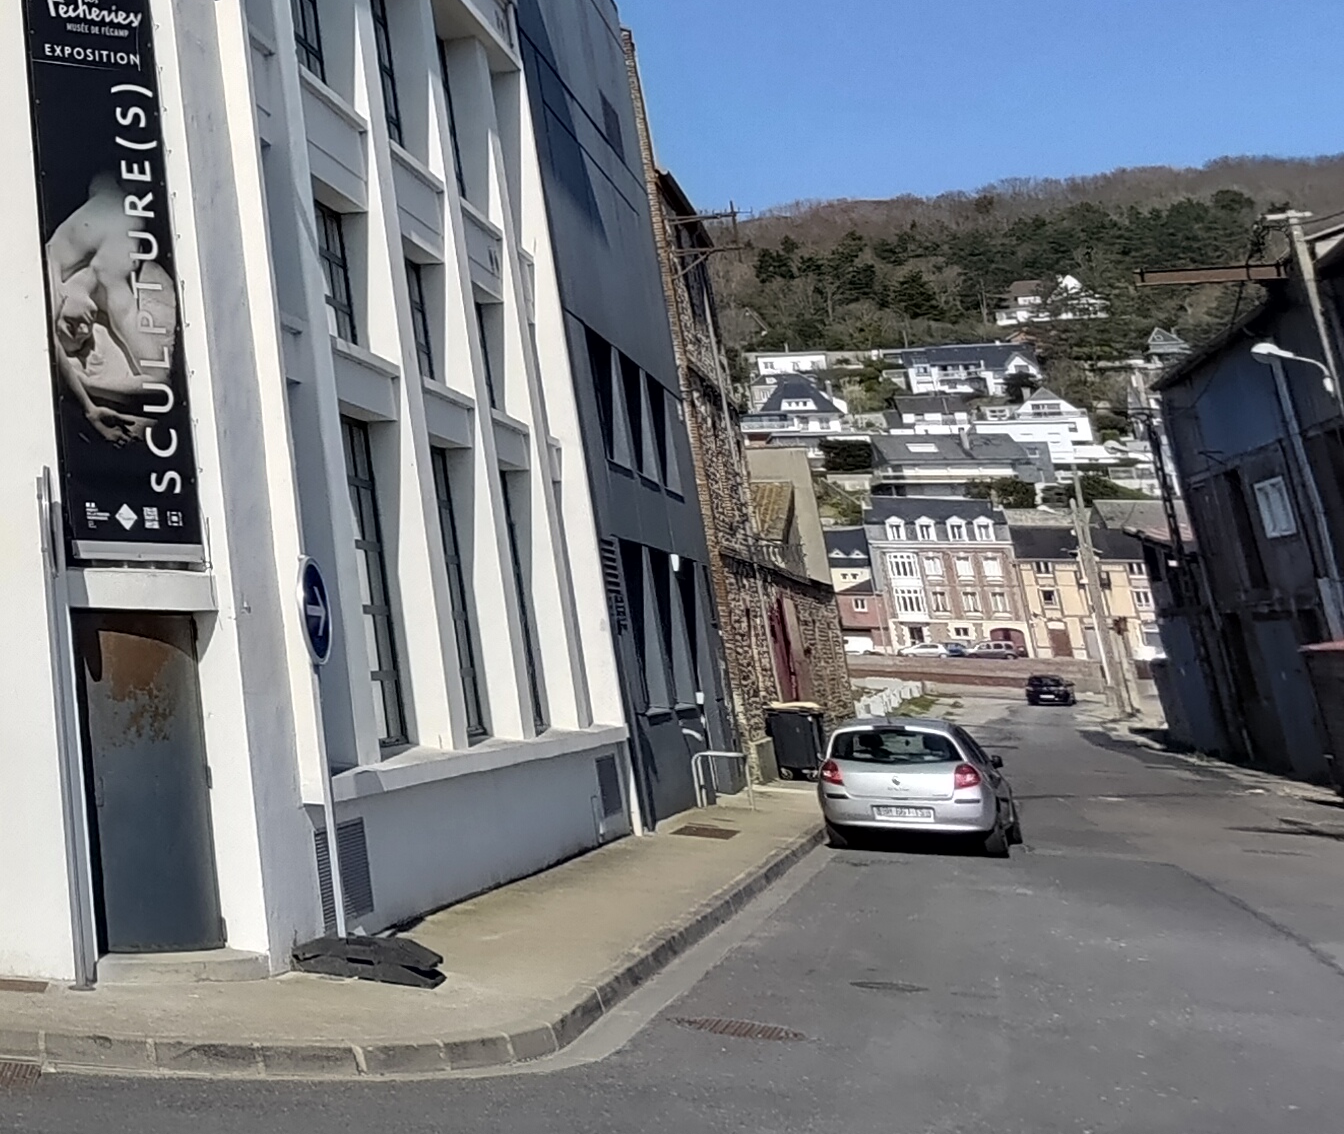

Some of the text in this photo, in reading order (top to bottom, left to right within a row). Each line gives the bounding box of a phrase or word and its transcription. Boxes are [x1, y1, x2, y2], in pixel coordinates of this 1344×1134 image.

[66, 21, 129, 37] MUSÉE DE FÉCAMP
[44, 43, 140, 65] EXPOSITION
[110, 83, 182, 495] SCULPTURE(S)
